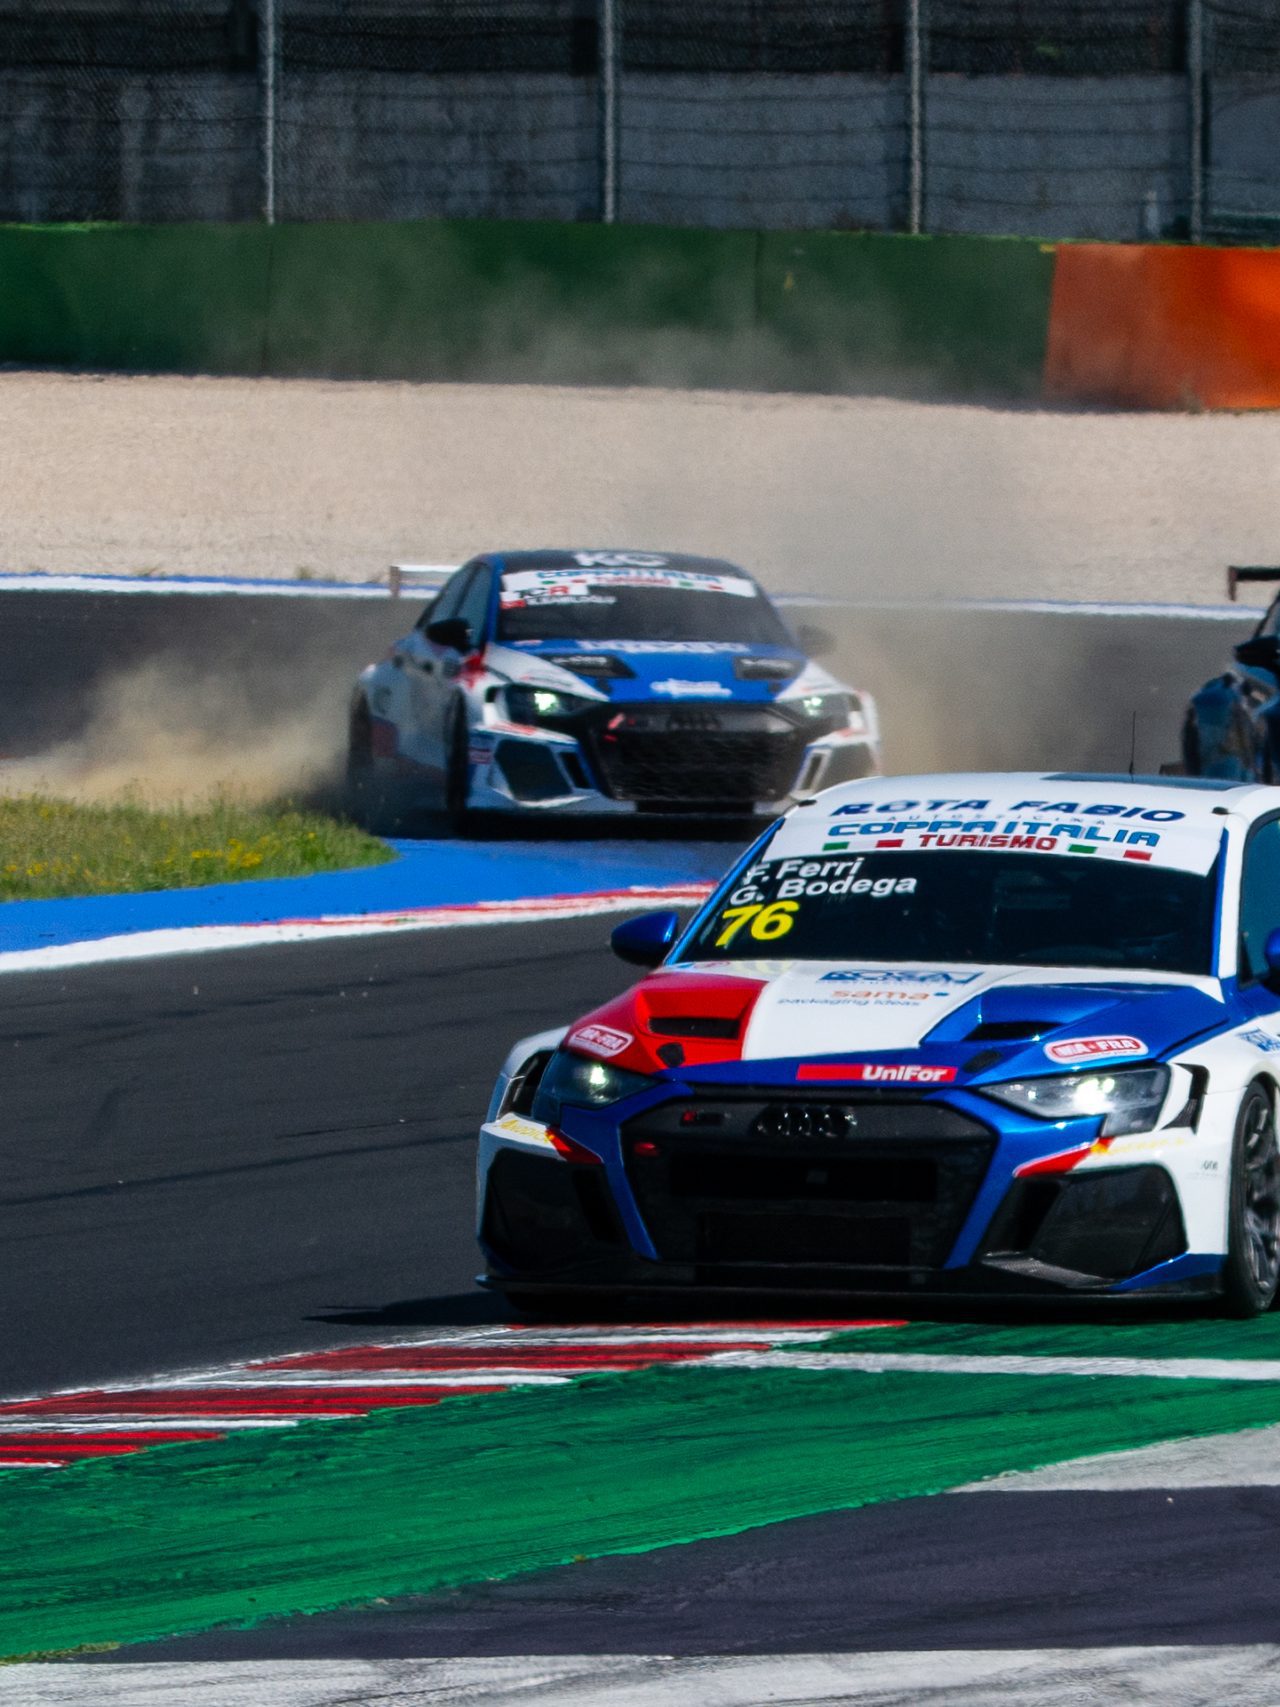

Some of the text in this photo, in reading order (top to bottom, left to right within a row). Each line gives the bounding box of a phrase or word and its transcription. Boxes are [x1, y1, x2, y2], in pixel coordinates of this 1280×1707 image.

[830, 800, 1187, 823] ROTA FABIO
[827, 820, 1161, 848] COPPA ITALIA
[919, 833, 1059, 851] TURISMO
[742, 856, 866, 886] F. Ferri
[729, 875, 918, 907] G. Bodega
[715, 899, 800, 947] 76
[832, 988, 930, 1001] sama
[861, 1064, 951, 1082] UniFor
